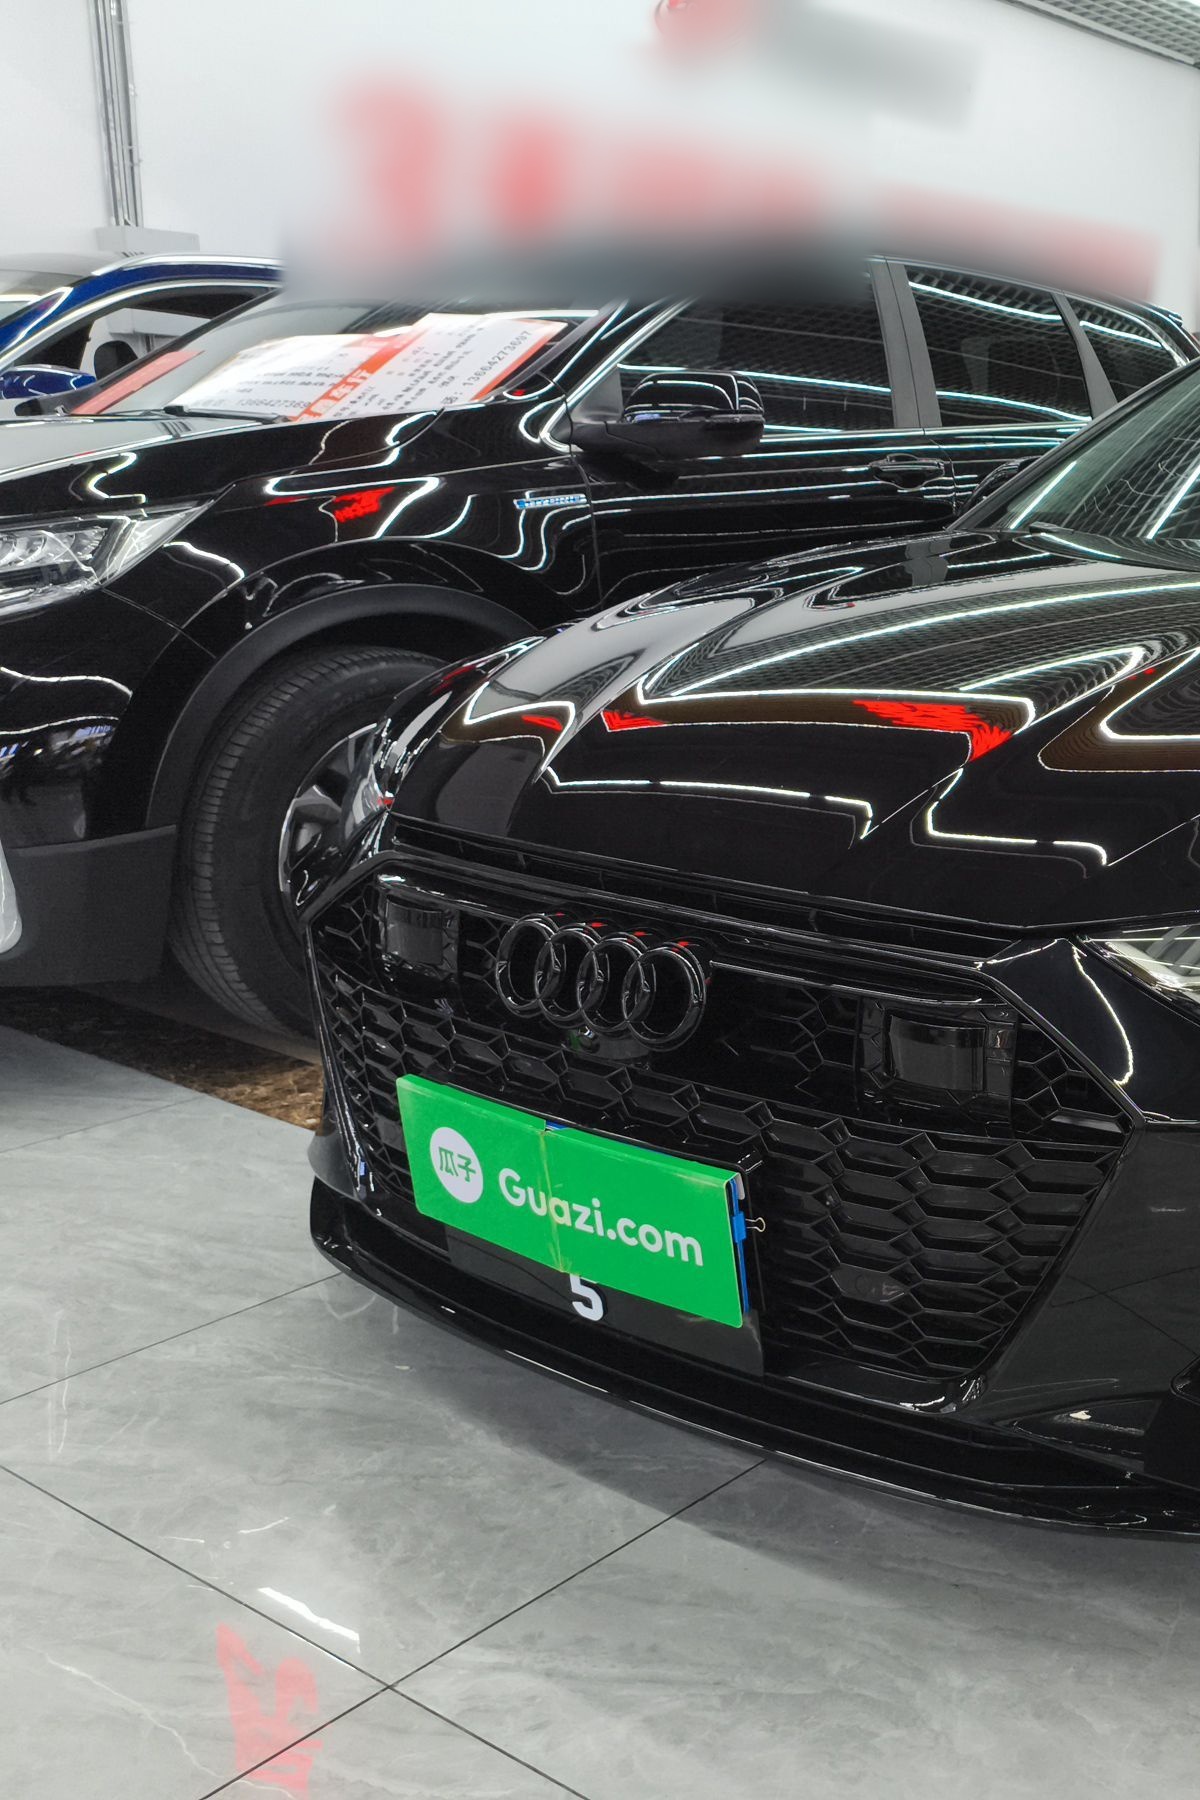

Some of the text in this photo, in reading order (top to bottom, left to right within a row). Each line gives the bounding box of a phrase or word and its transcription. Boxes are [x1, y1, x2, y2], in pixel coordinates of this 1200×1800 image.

[438, 1147, 477, 1182] 瓜子
[498, 1168, 704, 1267] Guazi.com
[569, 1273, 605, 1322] 5
